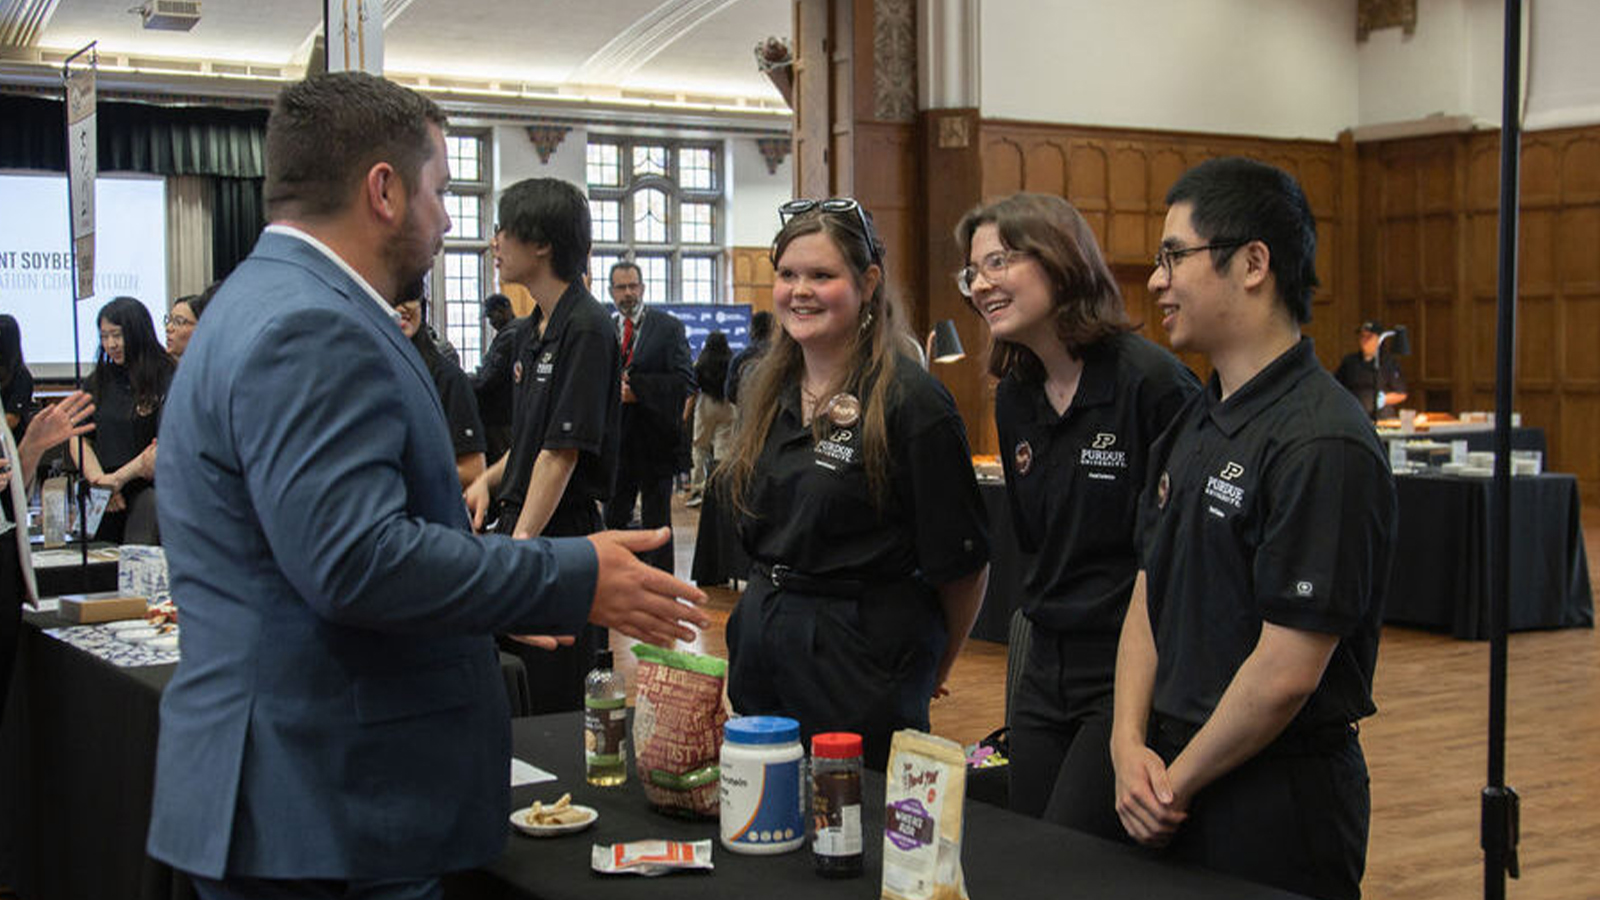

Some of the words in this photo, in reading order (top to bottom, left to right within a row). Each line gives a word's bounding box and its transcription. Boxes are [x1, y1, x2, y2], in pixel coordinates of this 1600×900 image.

[21, 251, 71, 270] SOYBE
[1092, 433, 1116, 449] P
[1081, 449, 1126, 462] PURDUE
[1220, 461, 1244, 480] P
[1207, 476, 1244, 501] PURDUE
